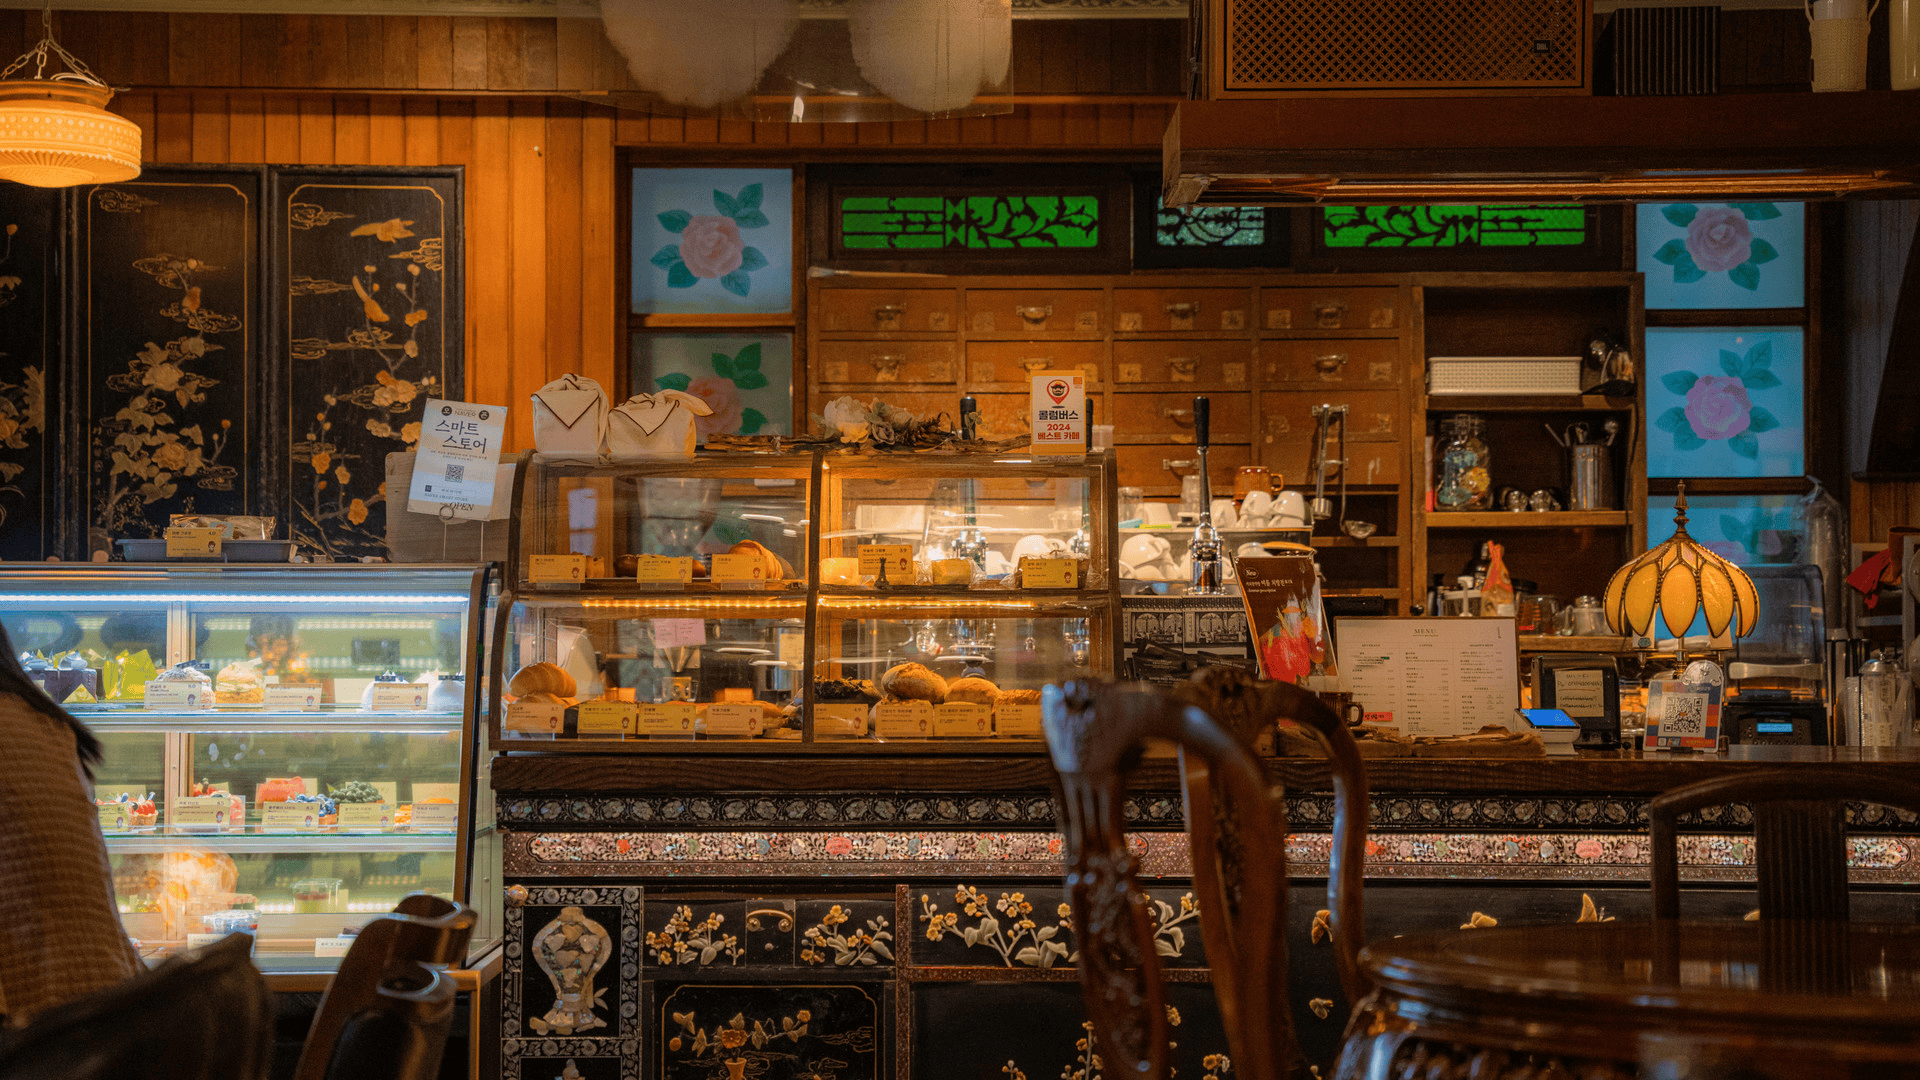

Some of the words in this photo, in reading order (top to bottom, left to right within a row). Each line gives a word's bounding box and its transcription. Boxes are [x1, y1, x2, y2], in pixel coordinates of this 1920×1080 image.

[435, 420, 480, 436] 스마트
[1047, 423, 1071, 431] 2024
[1038, 431, 1062, 440] 베스트
[1063, 431, 1080, 440] 카페
[442, 435, 487, 454] 스토어
[449, 502, 475, 511] OPEN
